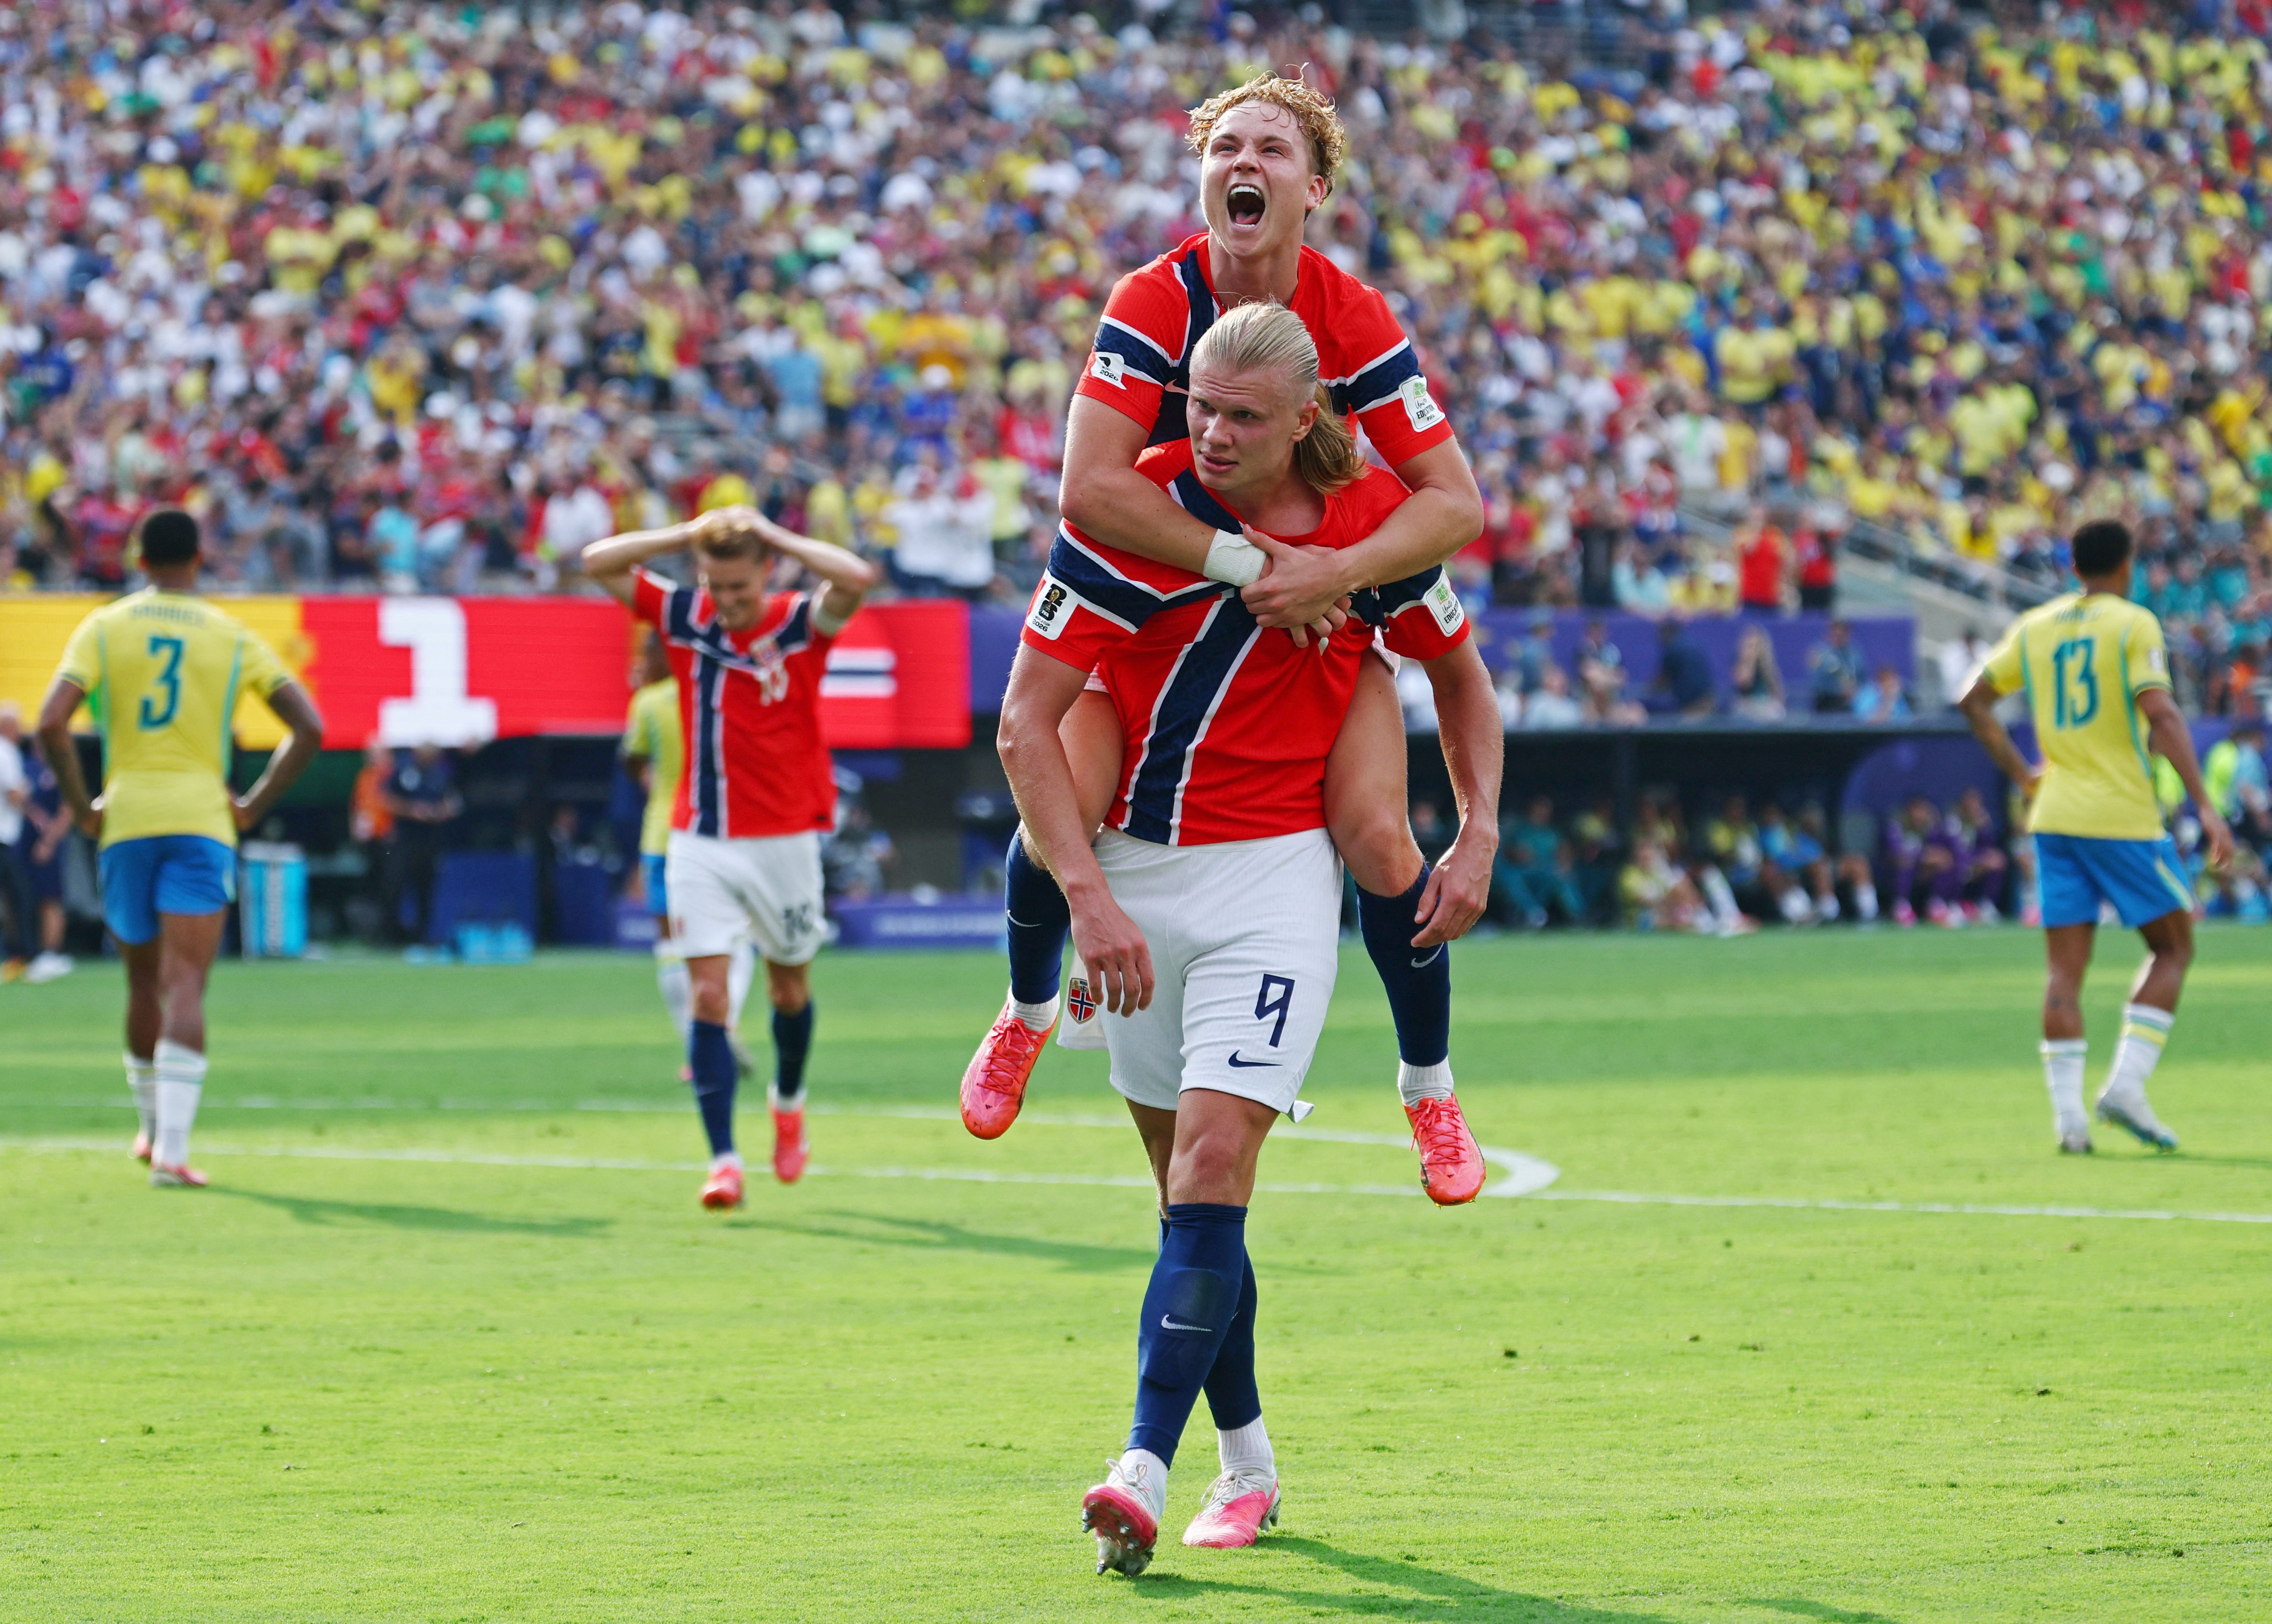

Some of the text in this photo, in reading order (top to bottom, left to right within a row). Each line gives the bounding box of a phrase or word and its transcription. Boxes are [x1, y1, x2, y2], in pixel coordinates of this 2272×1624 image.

[378, 596, 497, 747] 1
[1032, 619, 1048, 632] 2026
[139, 636, 185, 729] 3
[2053, 636, 2100, 731] 13
[1255, 973, 1295, 1048] 9
